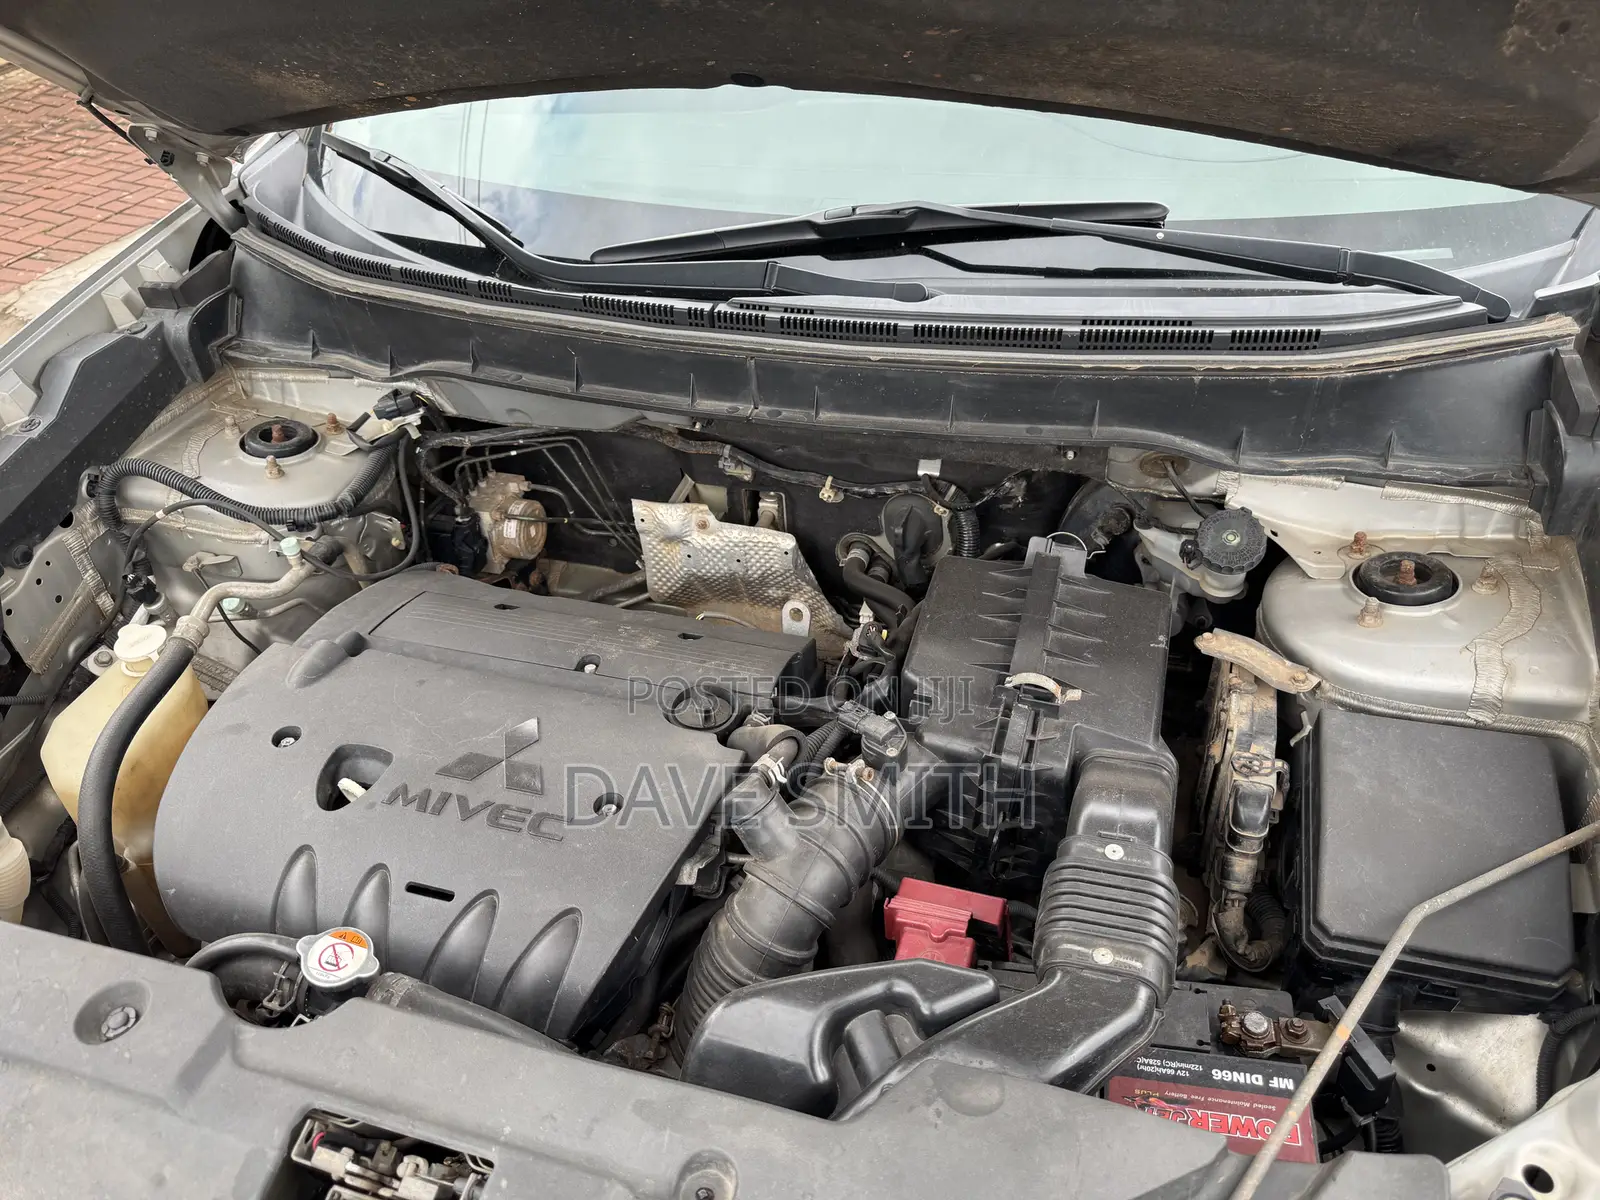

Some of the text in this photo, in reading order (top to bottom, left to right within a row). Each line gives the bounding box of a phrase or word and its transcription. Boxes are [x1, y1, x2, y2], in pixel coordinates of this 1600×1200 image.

[380, 782, 573, 842] MIVEC
[1136, 1063, 1190, 1077] 12V 66Ah(20hr)
[1211, 1068, 1294, 1090] MF DIN66
[1164, 1090, 1277, 1111] Sealed Maintenance Free Battery
